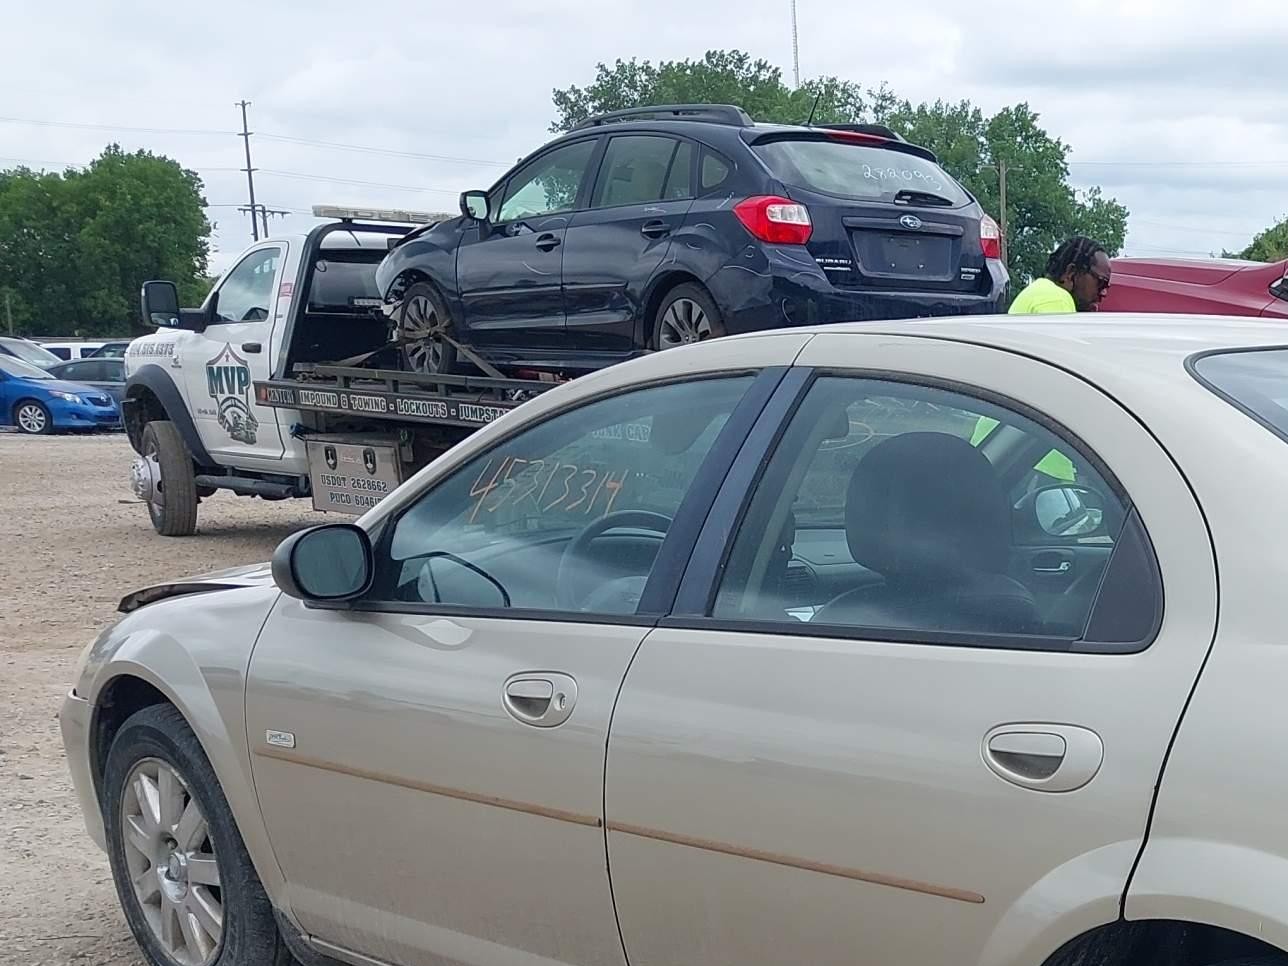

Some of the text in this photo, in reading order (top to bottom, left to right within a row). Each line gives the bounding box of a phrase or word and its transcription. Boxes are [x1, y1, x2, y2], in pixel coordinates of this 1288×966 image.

[207, 366, 250, 395] MVP
[299, 390, 338, 407] IMPOUND
[350, 395, 388, 412] TOWING
[397, 399, 447, 417] LOCKOUTS
[320, 474, 347, 487] USDOT
[468, 456, 628, 523] 45313314
